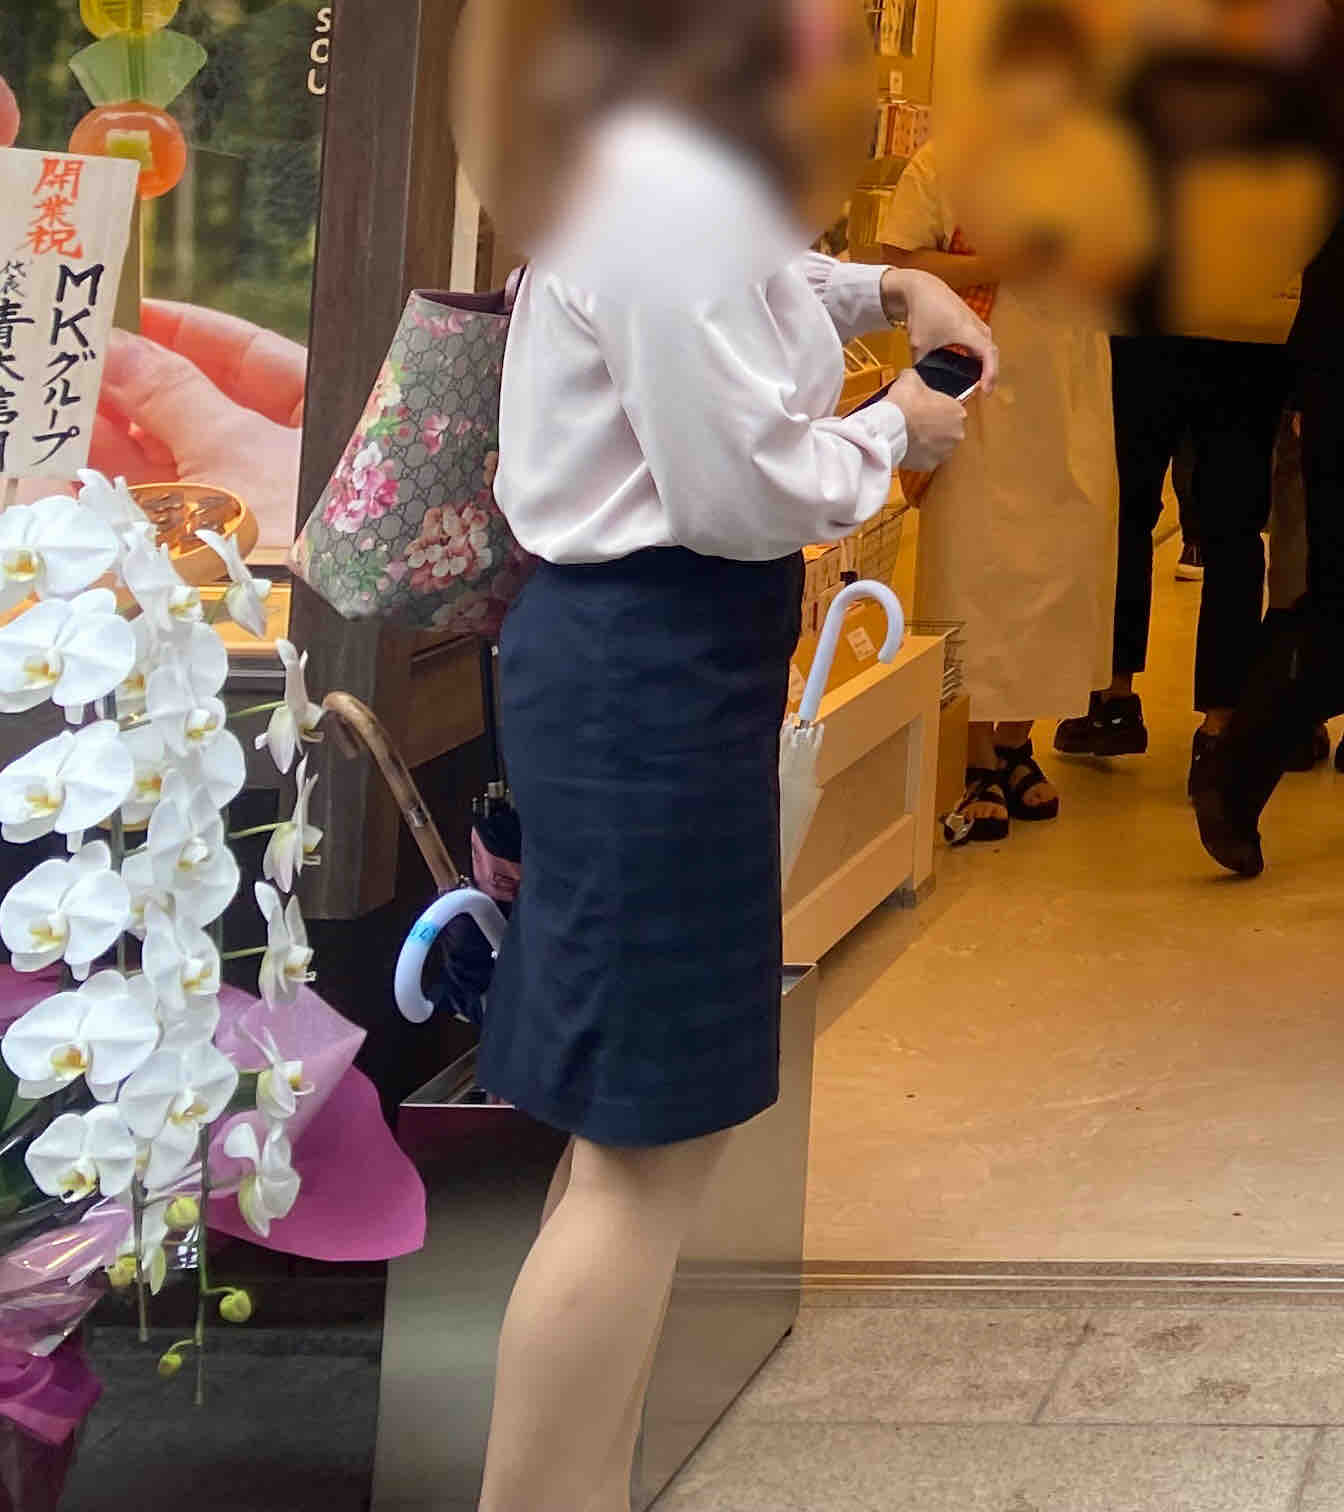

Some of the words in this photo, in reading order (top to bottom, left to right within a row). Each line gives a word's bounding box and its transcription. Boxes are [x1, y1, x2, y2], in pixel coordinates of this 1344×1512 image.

[25, 157, 85, 260] 開業祝
[30, 263, 104, 467] MKグループ
